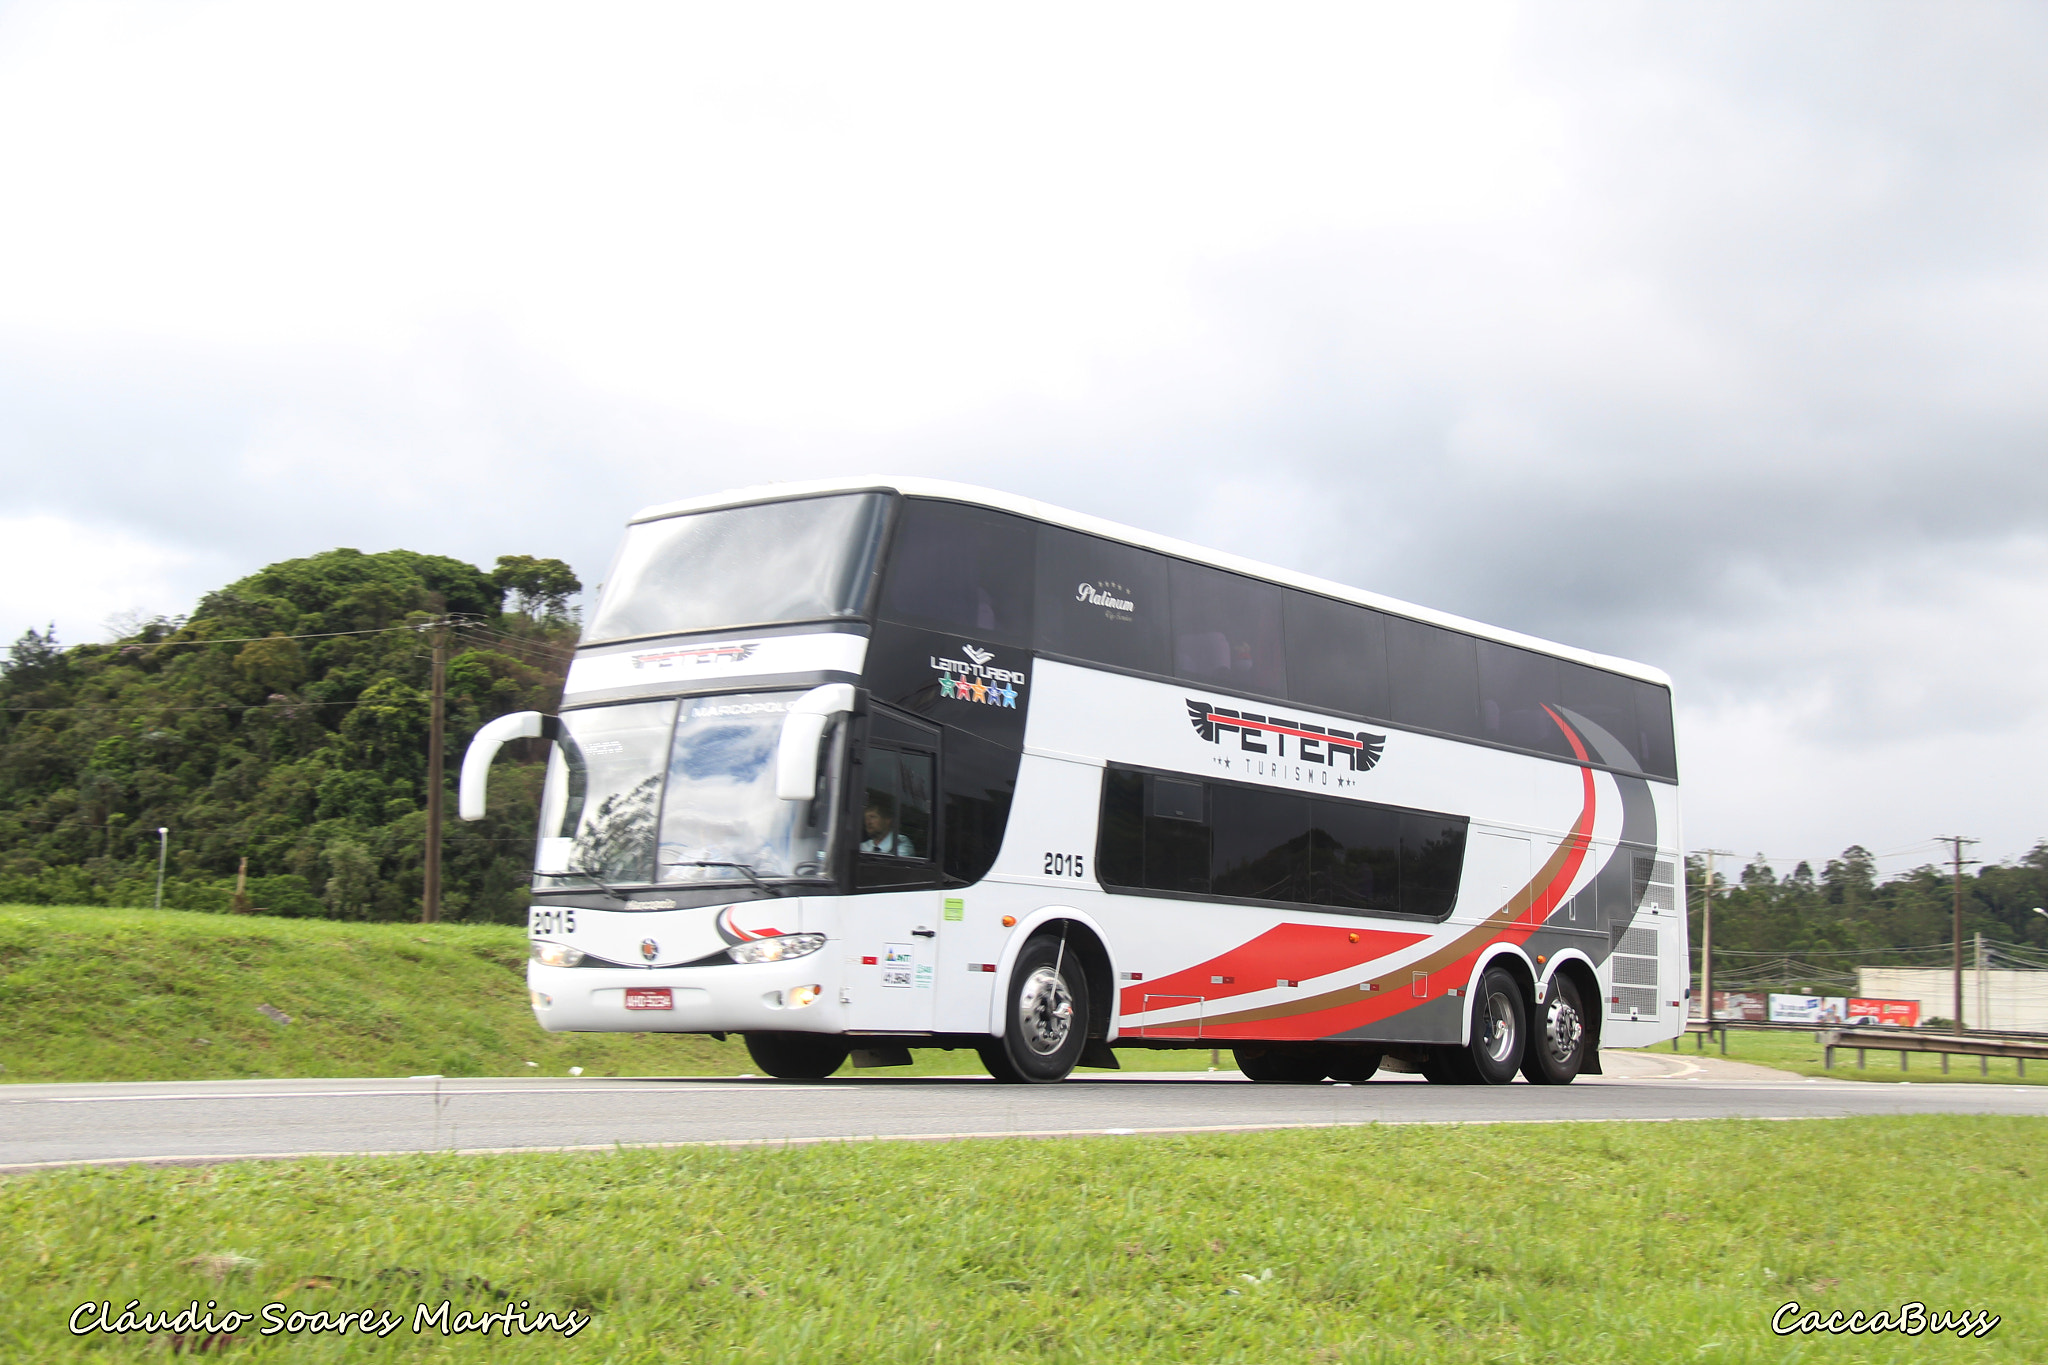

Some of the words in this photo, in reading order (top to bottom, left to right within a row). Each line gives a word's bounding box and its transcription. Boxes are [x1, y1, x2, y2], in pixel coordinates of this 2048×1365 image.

[1075, 582, 1134, 612] Platinum
[1214, 706, 1356, 771] PETER
[1245, 758, 1327, 786] TURISMO
[1044, 852, 1084, 878] 2015
[533, 910, 576, 935] 2015
